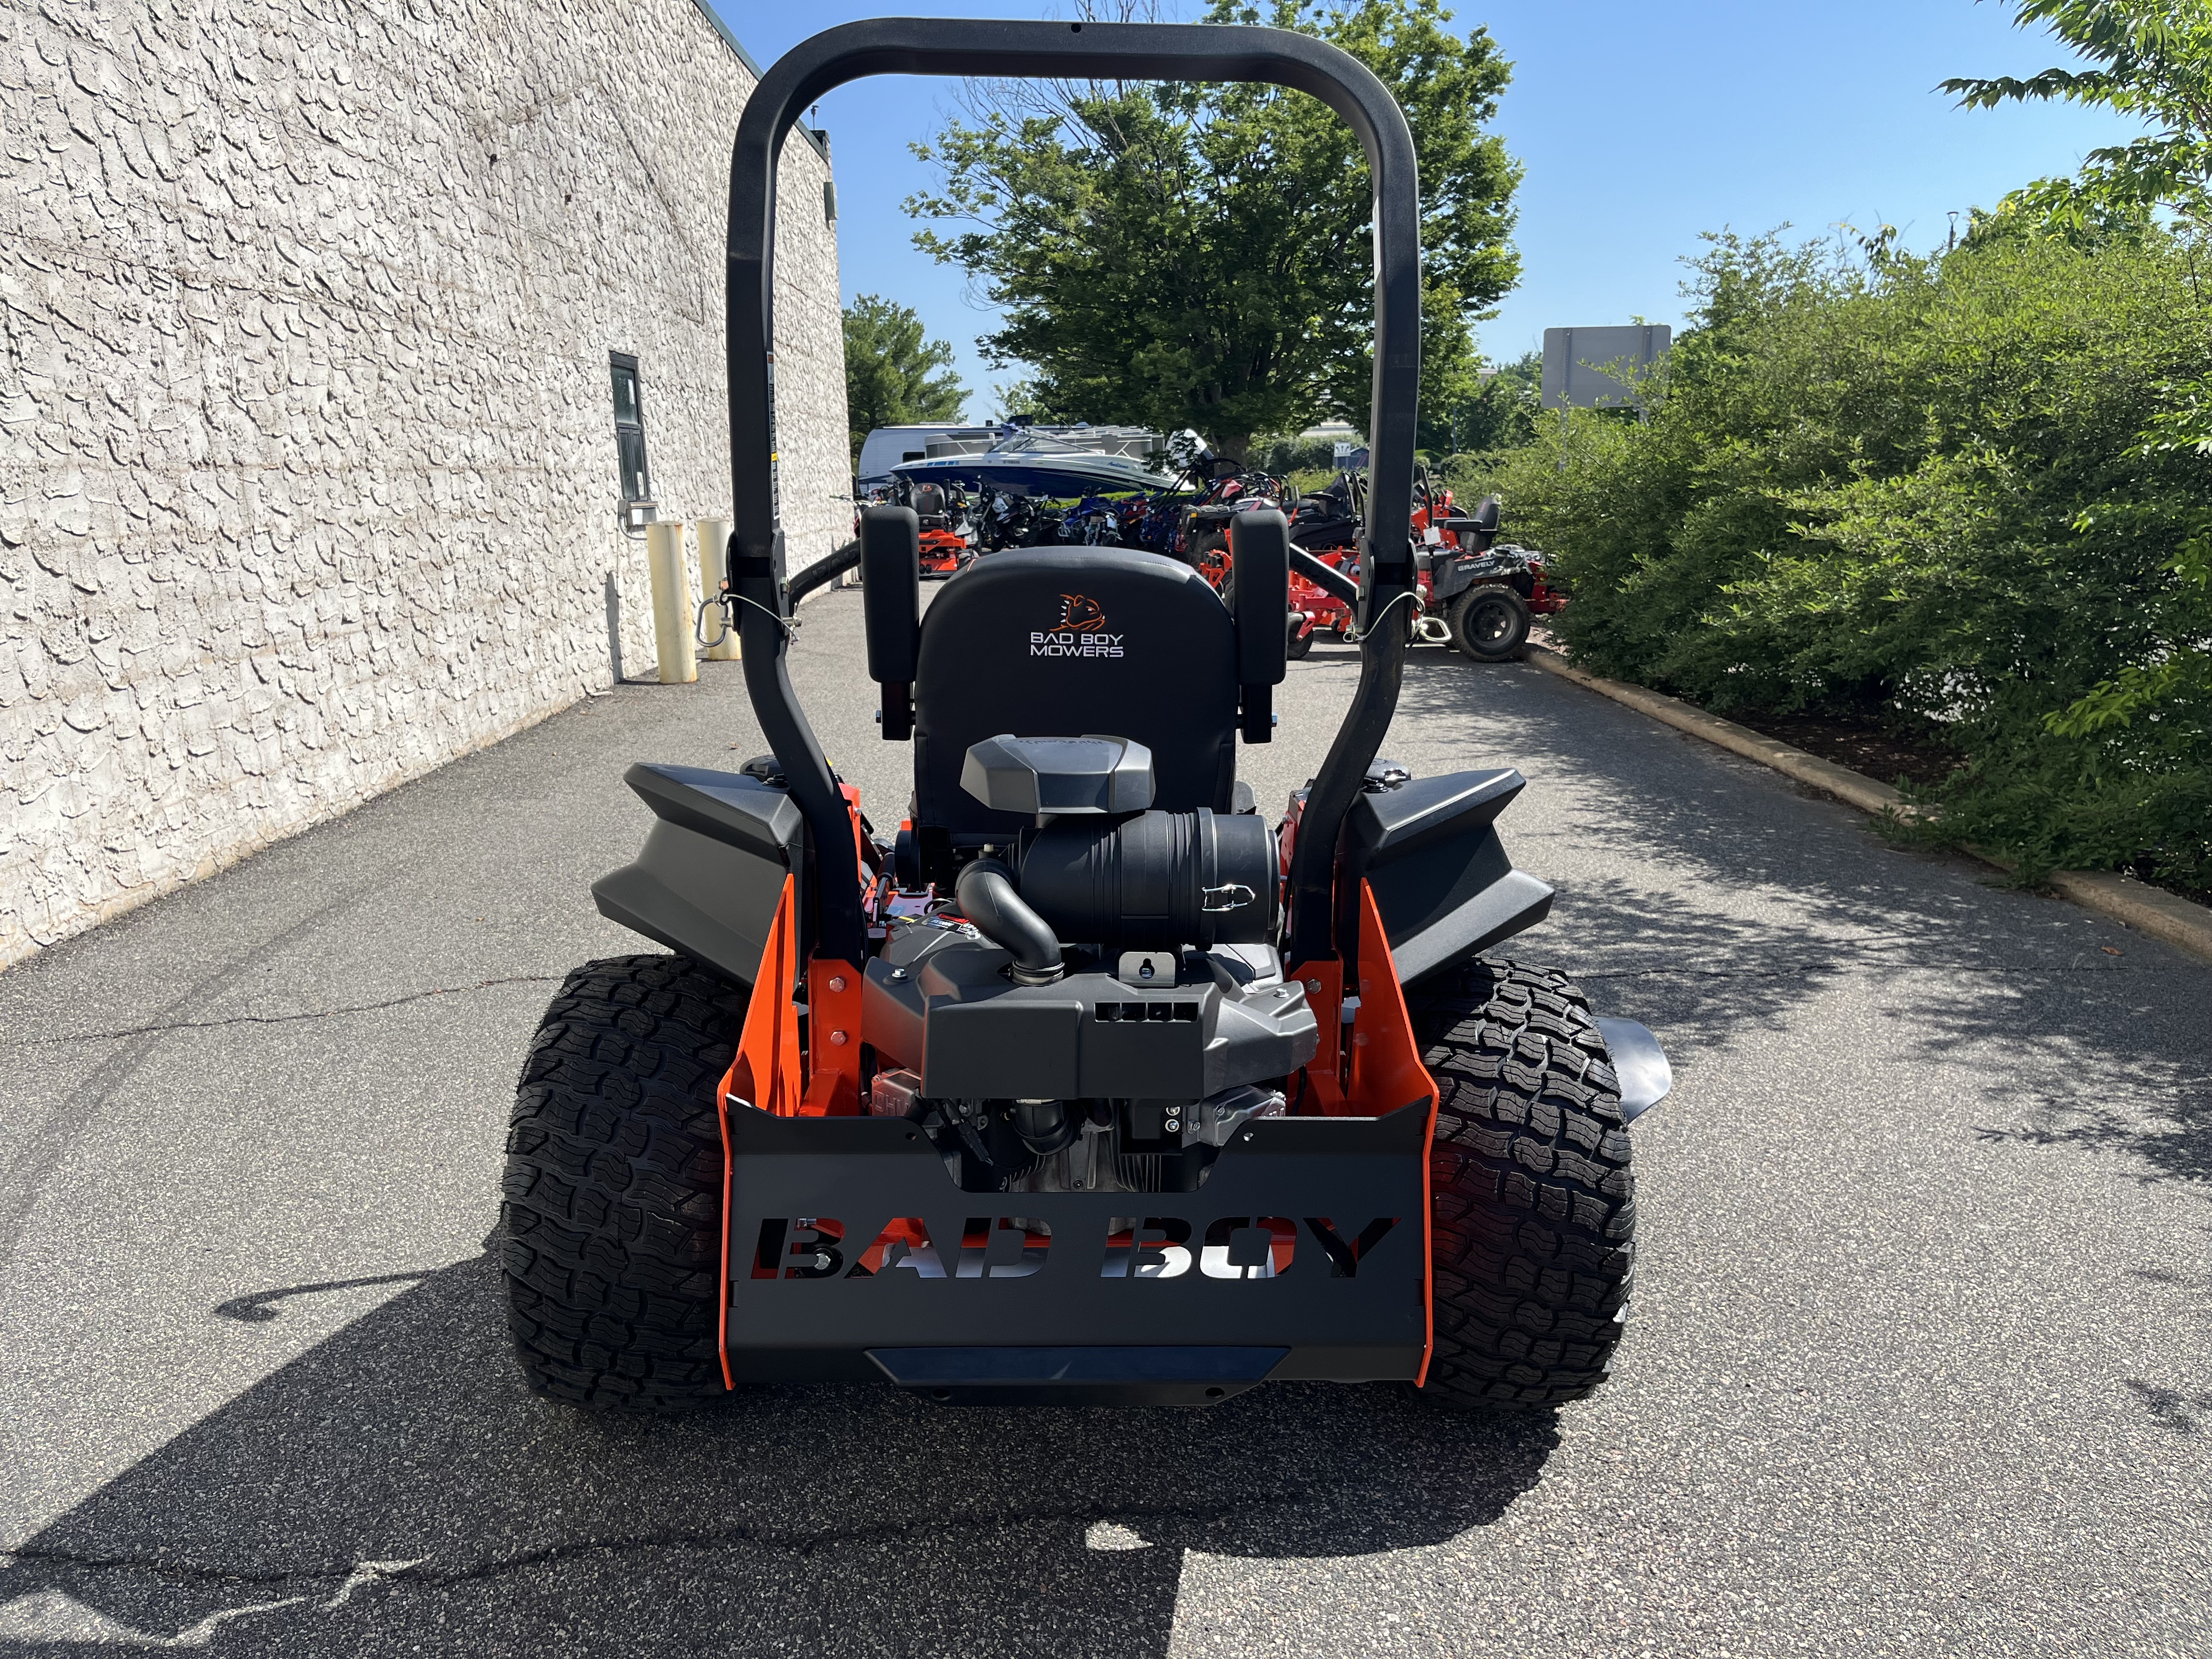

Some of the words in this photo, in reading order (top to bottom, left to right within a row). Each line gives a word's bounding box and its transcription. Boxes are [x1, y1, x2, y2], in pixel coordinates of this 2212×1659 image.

[1458, 560, 1495, 572] GRAVELY
[1030, 632, 1074, 644] BAD
[1081, 634, 1124, 645] BOY
[1030, 645, 1124, 657] MOWERS
[751, 1217, 1052, 1279] BAD
[1100, 1217, 1402, 1279] BOY
